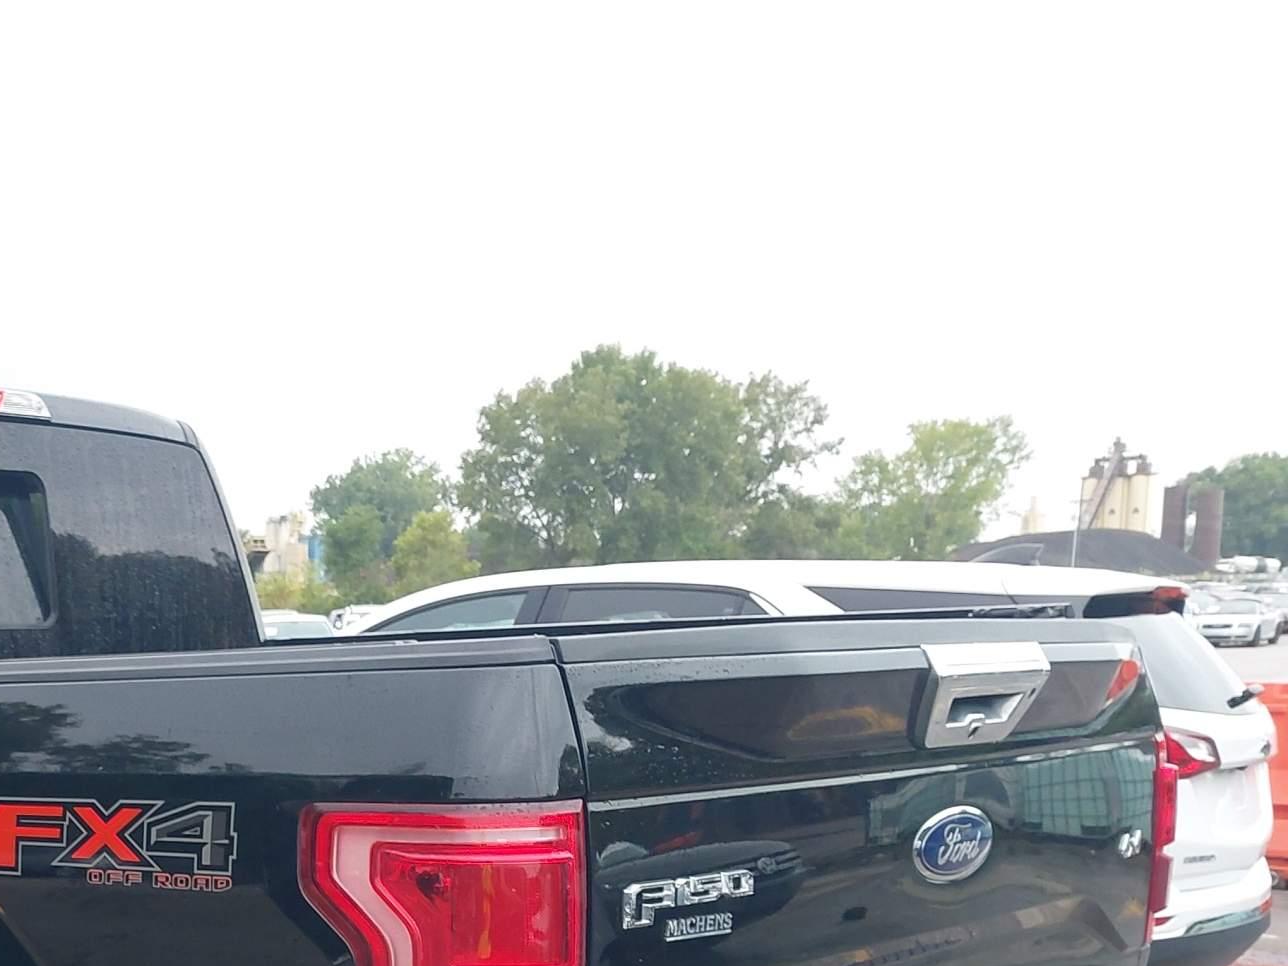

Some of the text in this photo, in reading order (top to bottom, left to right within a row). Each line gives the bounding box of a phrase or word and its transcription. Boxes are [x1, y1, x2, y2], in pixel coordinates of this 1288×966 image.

[937, 822, 982, 866] Ford
[86, 868, 233, 892] OFF ROAD
[664, 911, 734, 937] MACHENS
